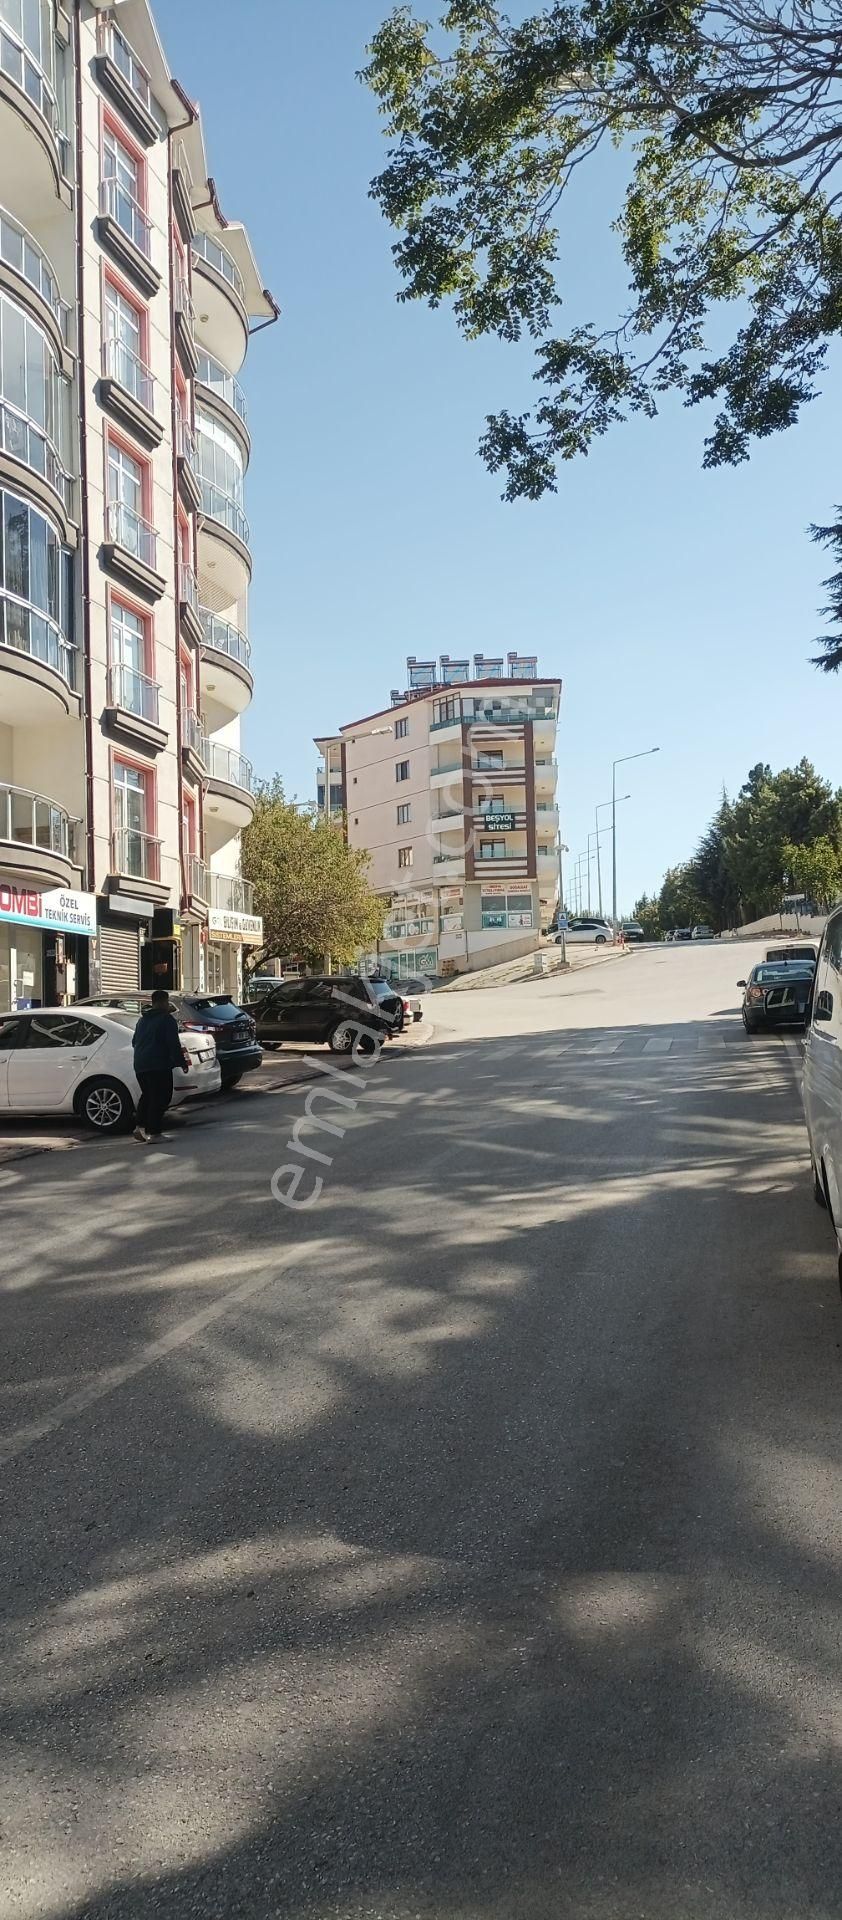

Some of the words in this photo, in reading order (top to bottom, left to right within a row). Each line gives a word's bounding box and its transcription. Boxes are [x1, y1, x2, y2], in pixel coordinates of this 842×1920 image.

[485, 814, 514, 823] BEŞYOL
[60, 894, 79, 910] ÖZEL
[45, 908, 68, 923] TEKNİK
[69, 913, 91, 926] SERVİS
